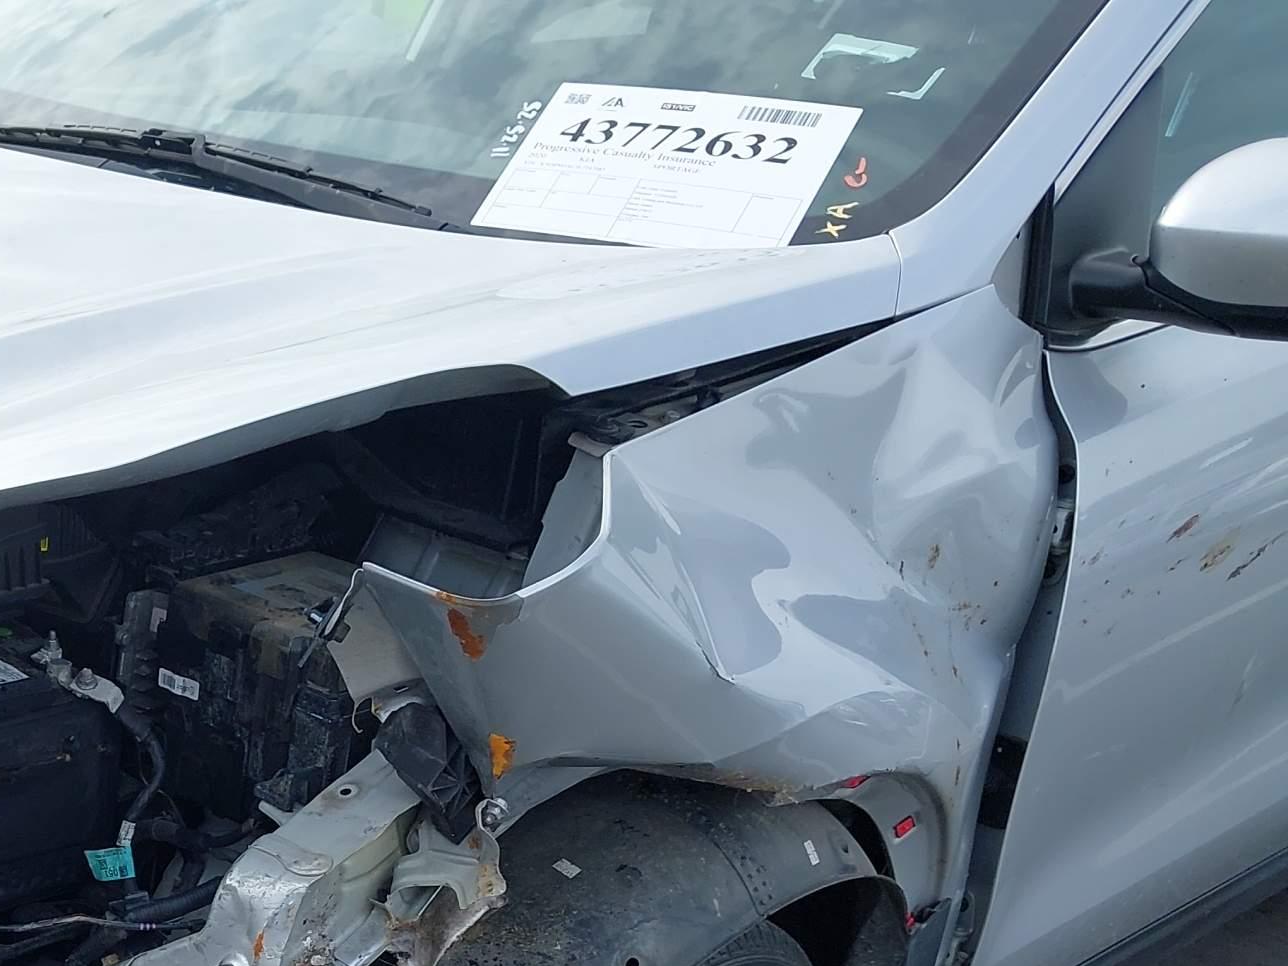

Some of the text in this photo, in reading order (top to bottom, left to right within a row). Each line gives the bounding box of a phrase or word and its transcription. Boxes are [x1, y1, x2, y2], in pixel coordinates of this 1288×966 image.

[559, 117, 799, 165] 43772632
[533, 142, 717, 167] Progressive Casualty Insurance
[579, 156, 596, 164] KIA
